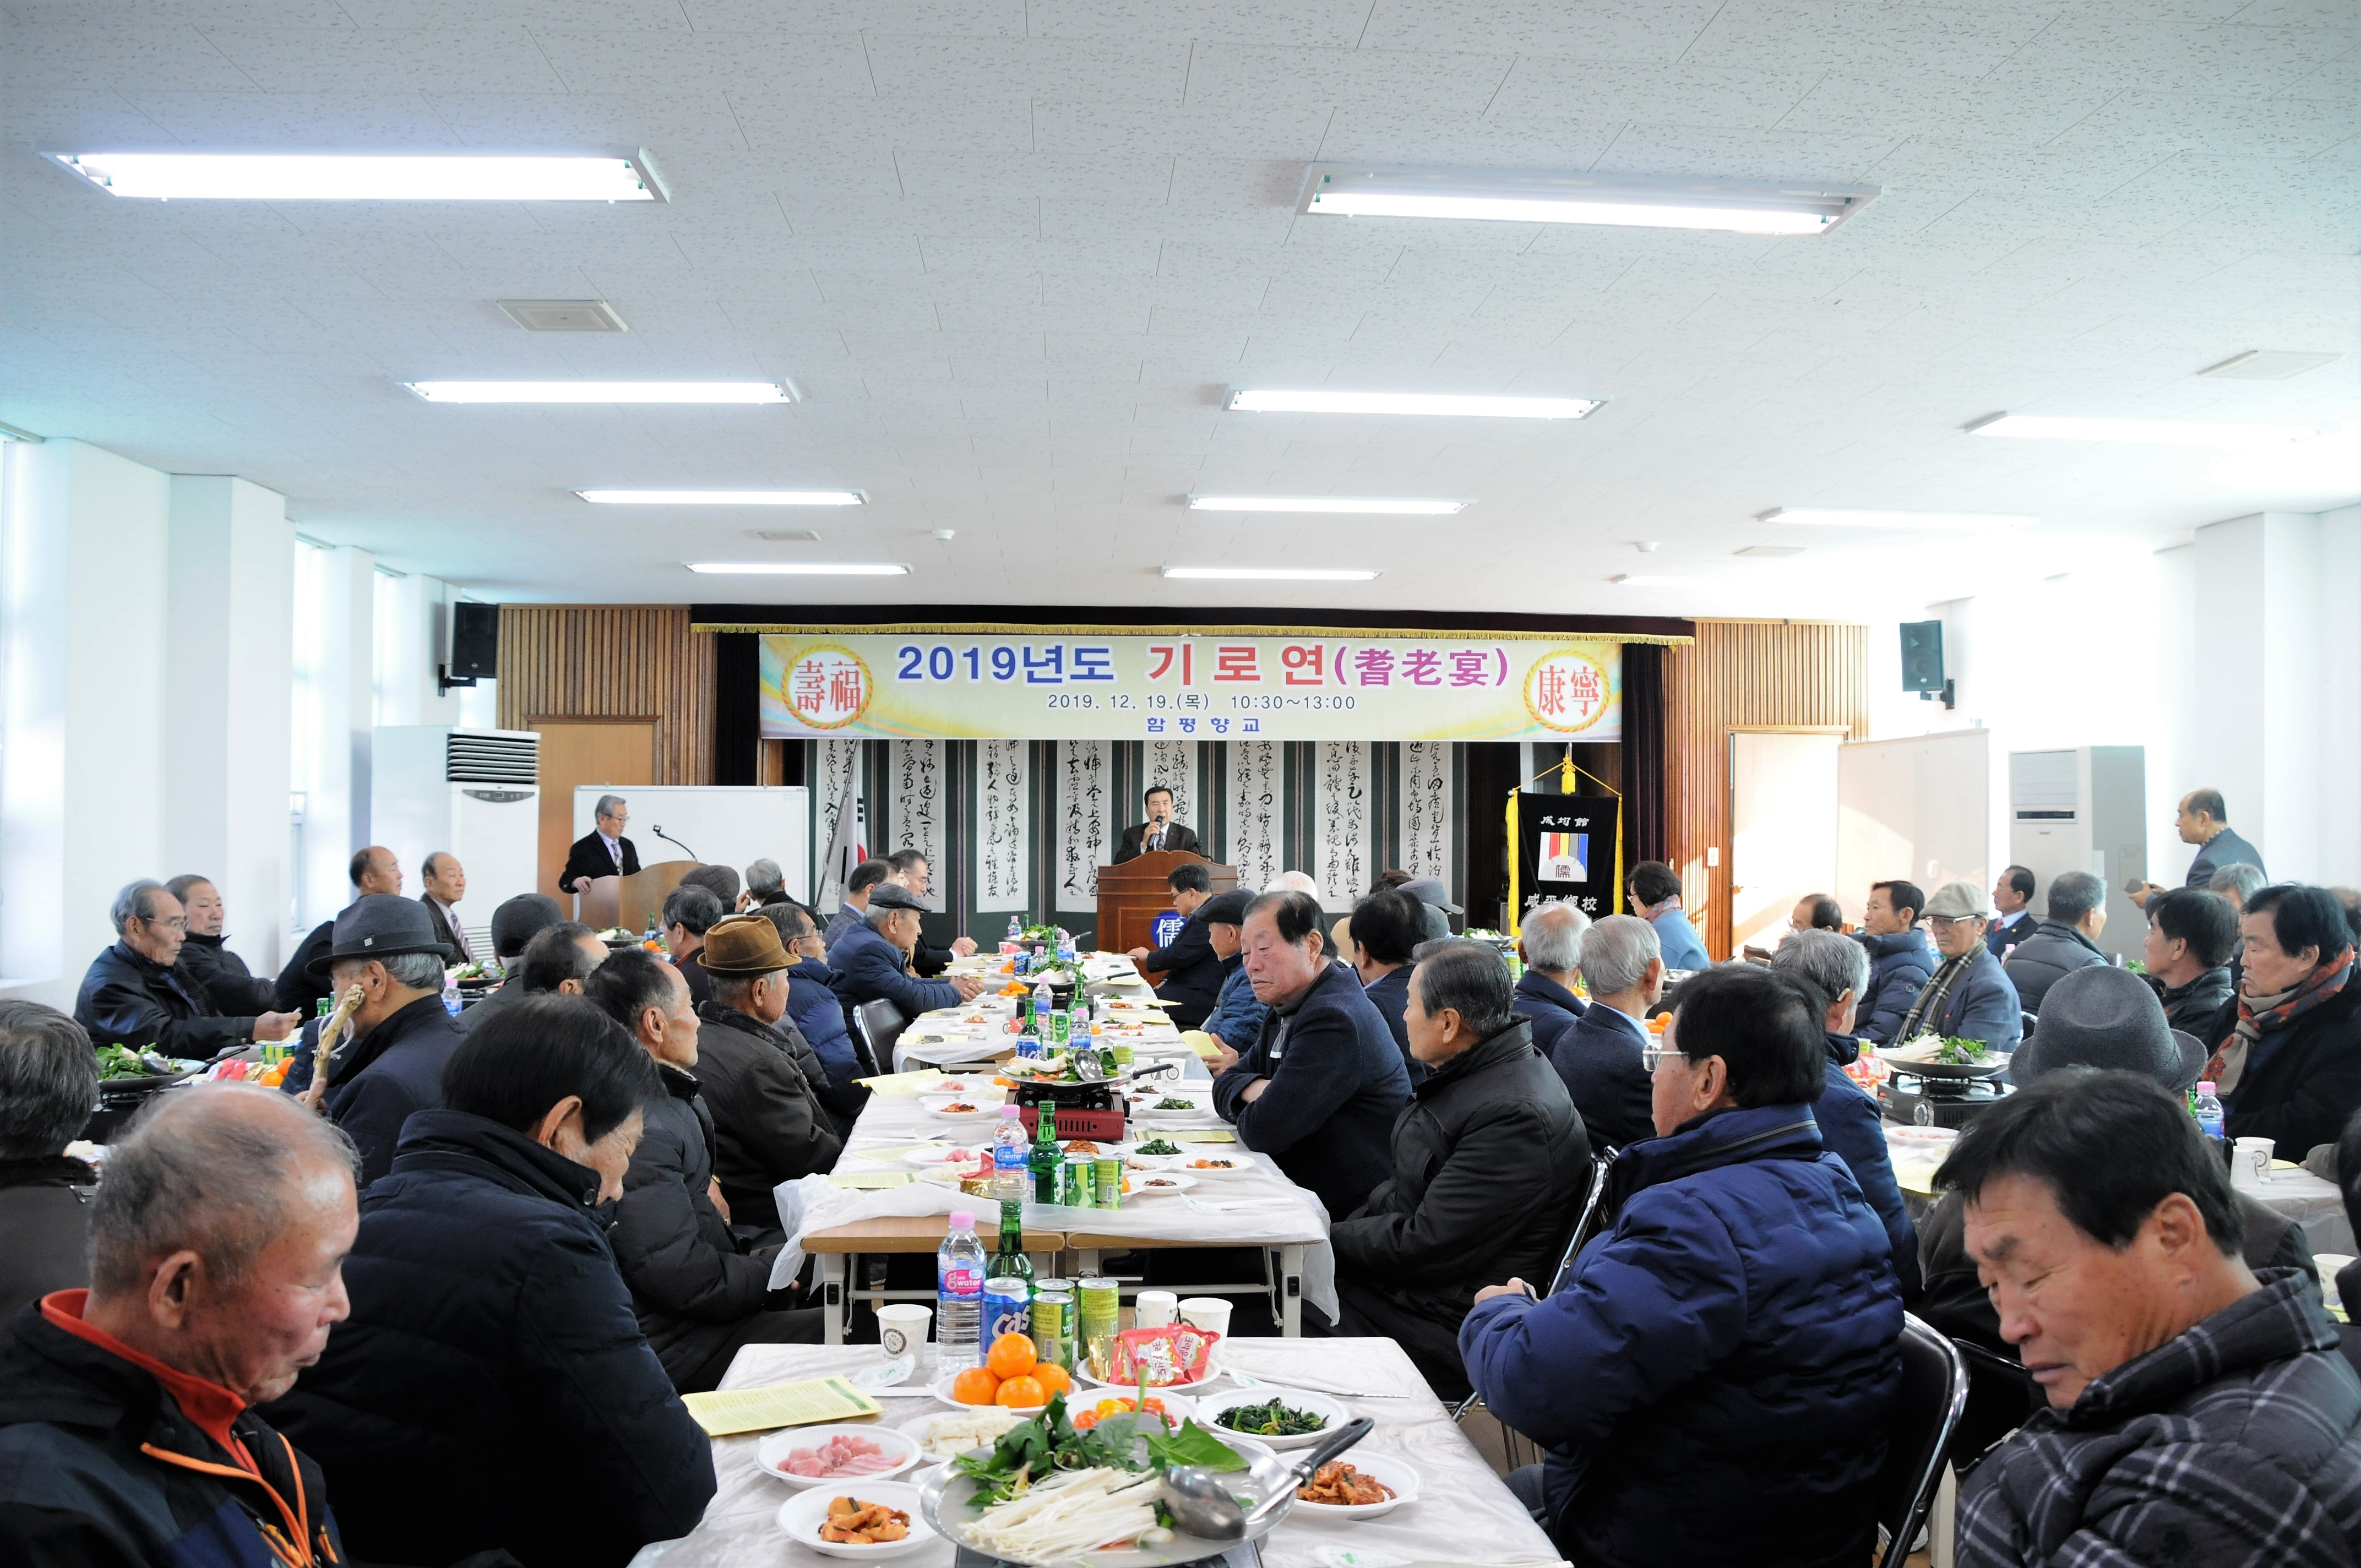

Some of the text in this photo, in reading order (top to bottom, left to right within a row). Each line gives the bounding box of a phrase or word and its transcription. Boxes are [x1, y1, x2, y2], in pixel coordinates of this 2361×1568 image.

[899, 645, 1114, 684] 2019년도
[1048, 693, 1355, 710] 2019. 12. 19.(목) 10:30~13:00
